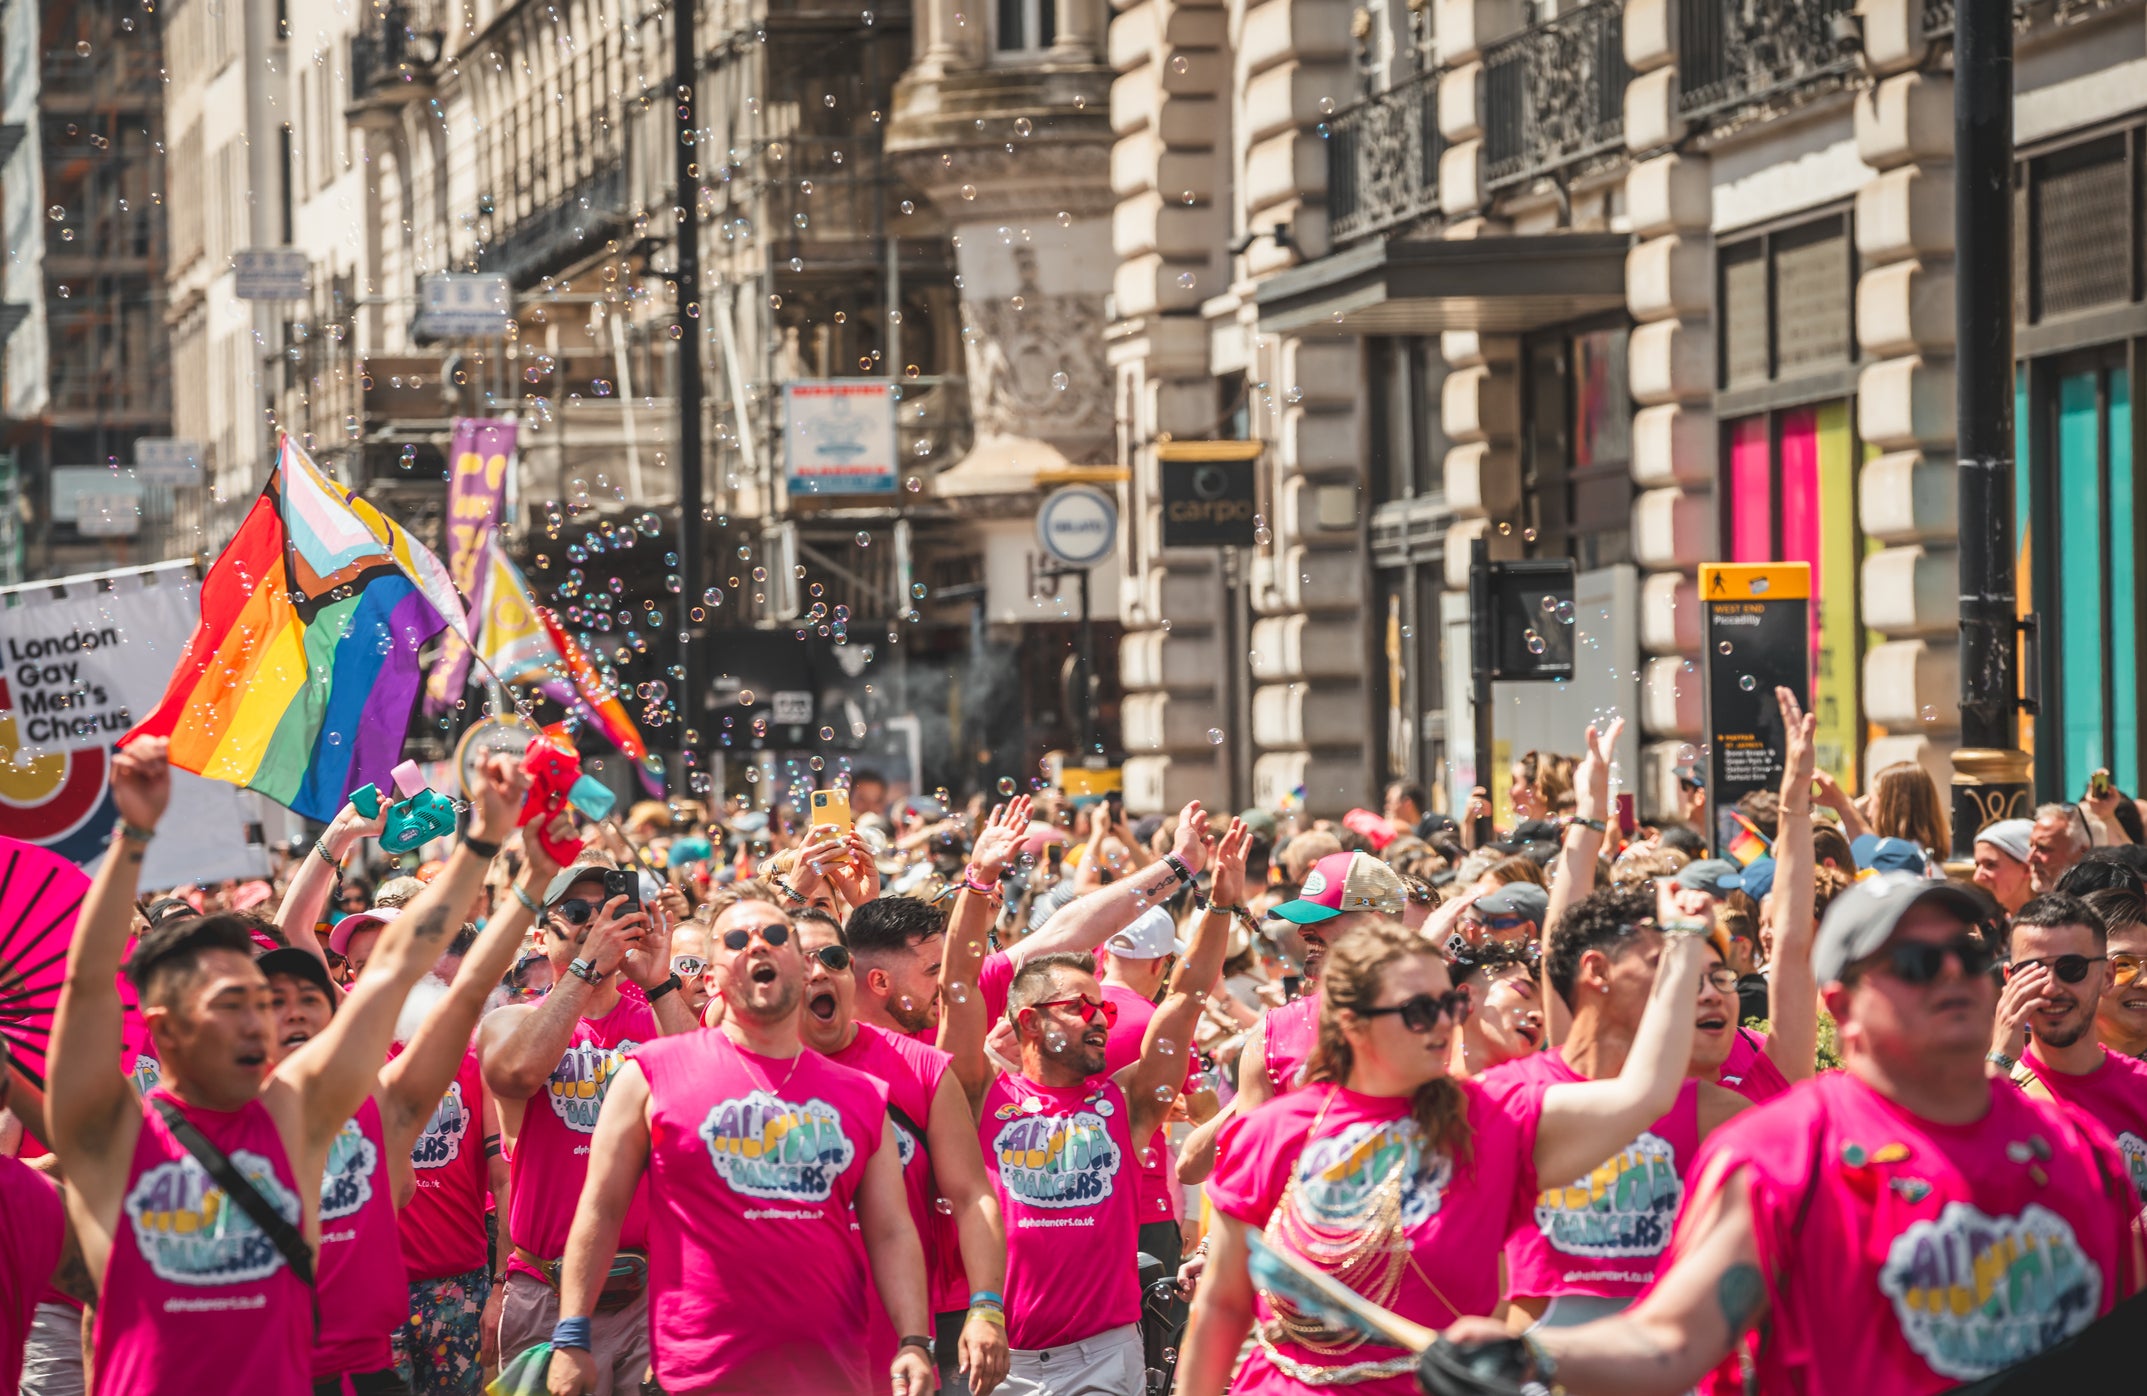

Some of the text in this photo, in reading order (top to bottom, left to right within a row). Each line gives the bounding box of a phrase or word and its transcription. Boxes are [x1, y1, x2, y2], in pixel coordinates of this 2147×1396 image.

[1169, 500, 1249, 525] carpo
[1713, 604, 1765, 613] WEST END
[1713, 614, 1760, 626] Piccadilly
[8, 628, 118, 662] London
[16, 661, 78, 688] Gay
[20, 686, 108, 716] Men's
[27, 710, 132, 743] Chorus
[552, 1053, 626, 1101] ALP
[713, 1105, 845, 1165] ALPHA
[1001, 1121, 1113, 1175] ALPHA
[730, 1158, 827, 1193] DANCERS
[1011, 1170, 1103, 1201] DANCERS
[141, 1171, 284, 1240] ALP
[1018, 1216, 1095, 1229] alphadancers.co.uk
[1552, 1213, 1663, 1248] DANCERS
